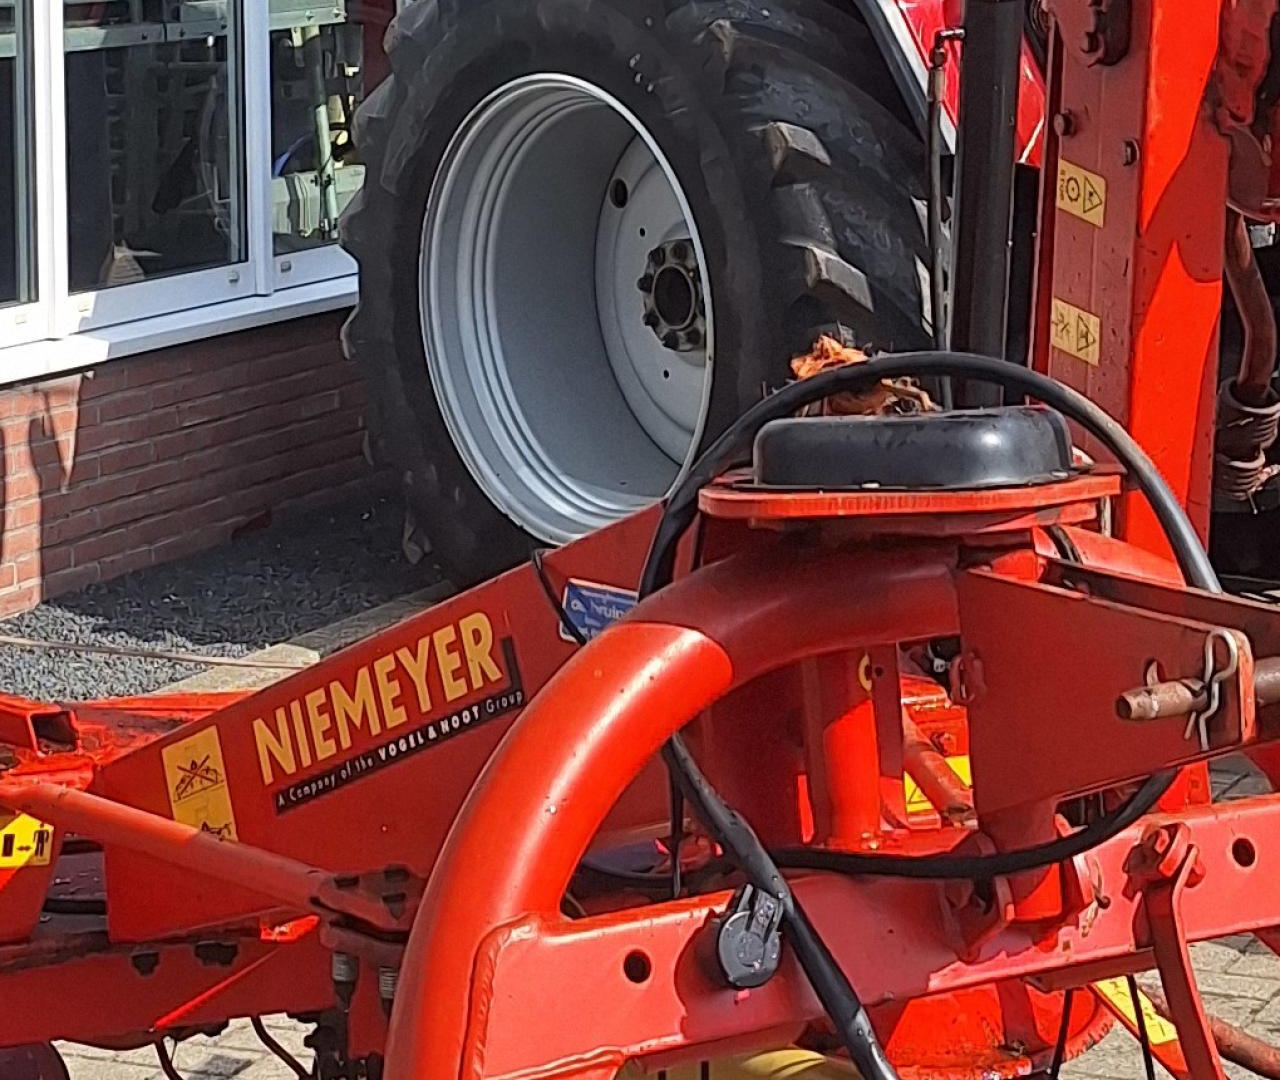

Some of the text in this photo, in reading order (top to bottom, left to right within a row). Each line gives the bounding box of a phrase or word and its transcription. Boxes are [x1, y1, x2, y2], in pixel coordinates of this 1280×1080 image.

[251, 611, 504, 786] NIEMEYER
[277, 793, 286, 807] A
[289, 773, 336, 801] Company
[340, 760, 352, 780] of
[354, 755, 374, 773] the
[485, 691, 523, 713] Group
